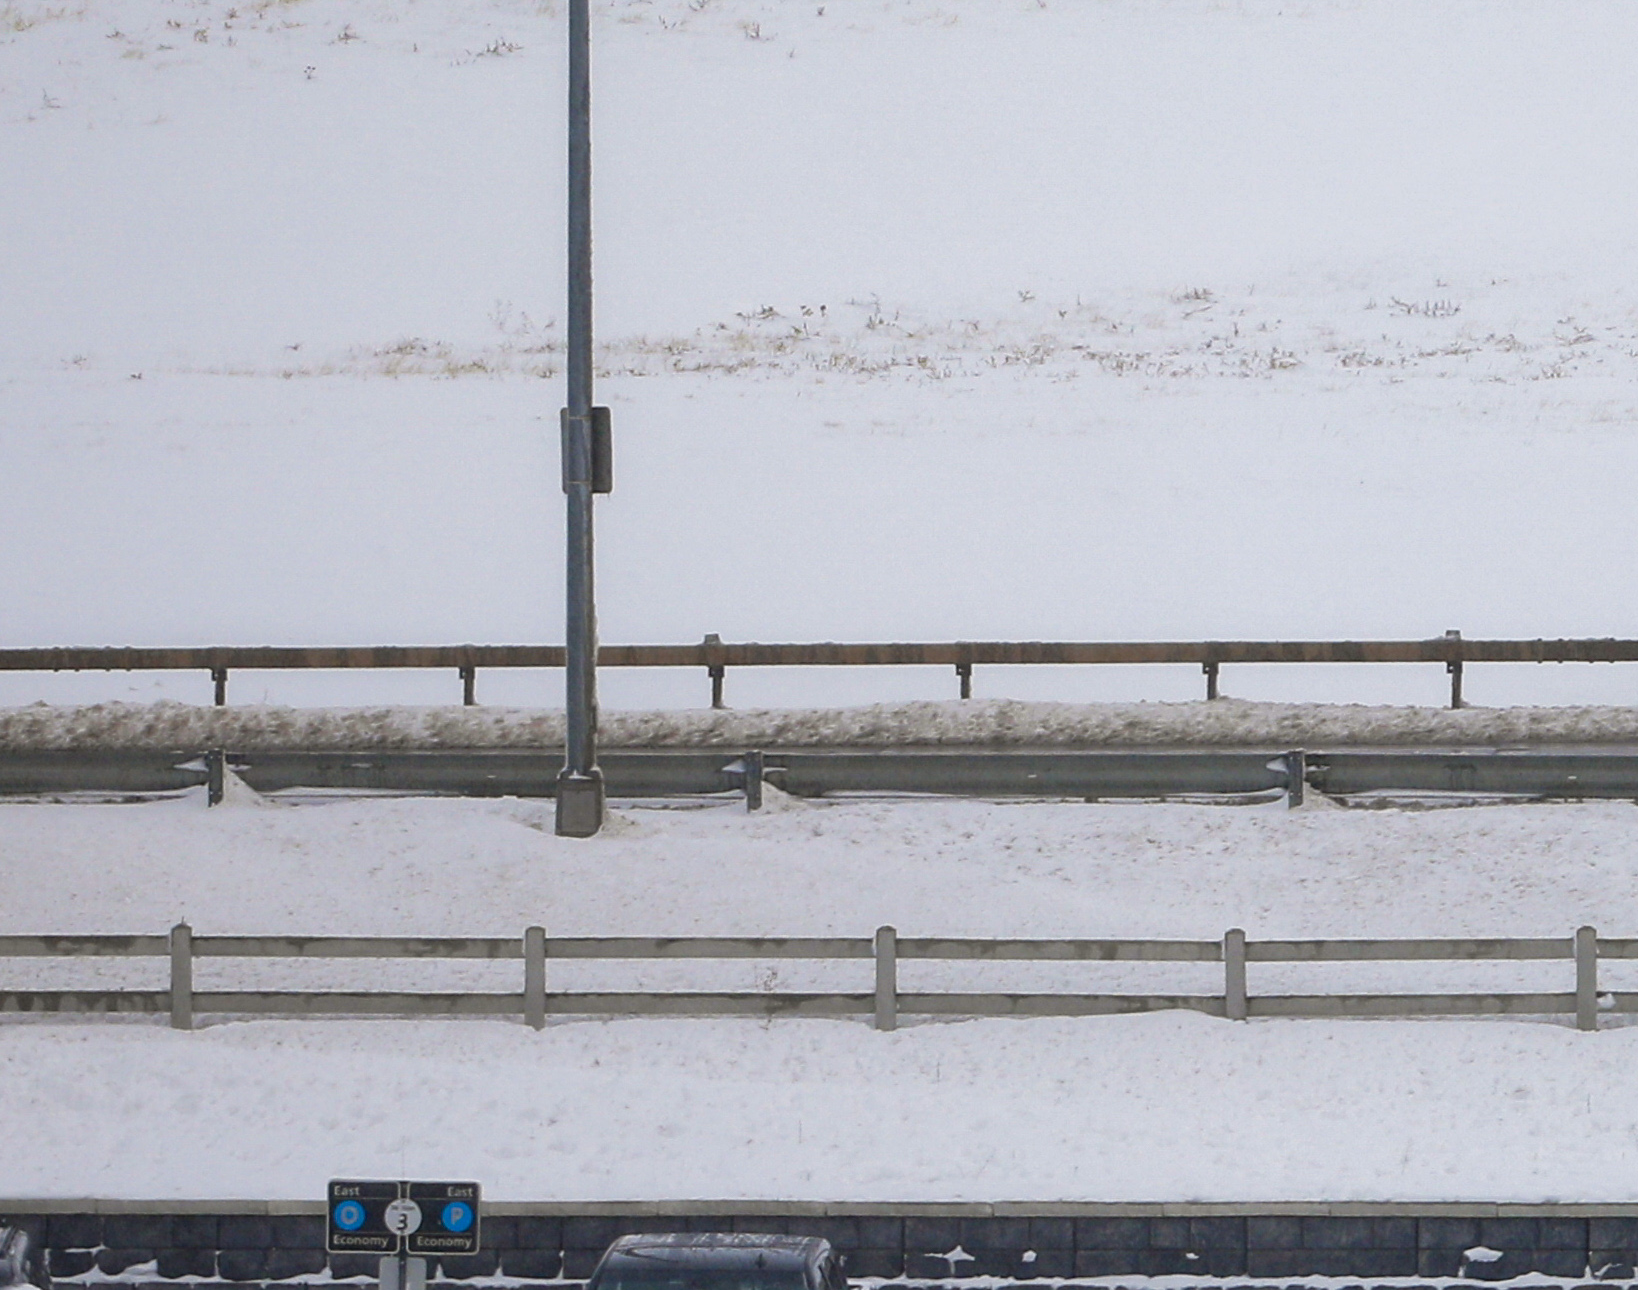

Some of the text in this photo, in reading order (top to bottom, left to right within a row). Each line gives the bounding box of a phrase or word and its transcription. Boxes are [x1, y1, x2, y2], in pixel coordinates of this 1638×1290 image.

[334, 1185, 360, 1196] East
[448, 1186, 473, 1197] East
[397, 1214, 408, 1230] 3
[451, 1207, 464, 1225] P
[333, 1235, 389, 1248] Economy
[417, 1236, 473, 1249] Economy
